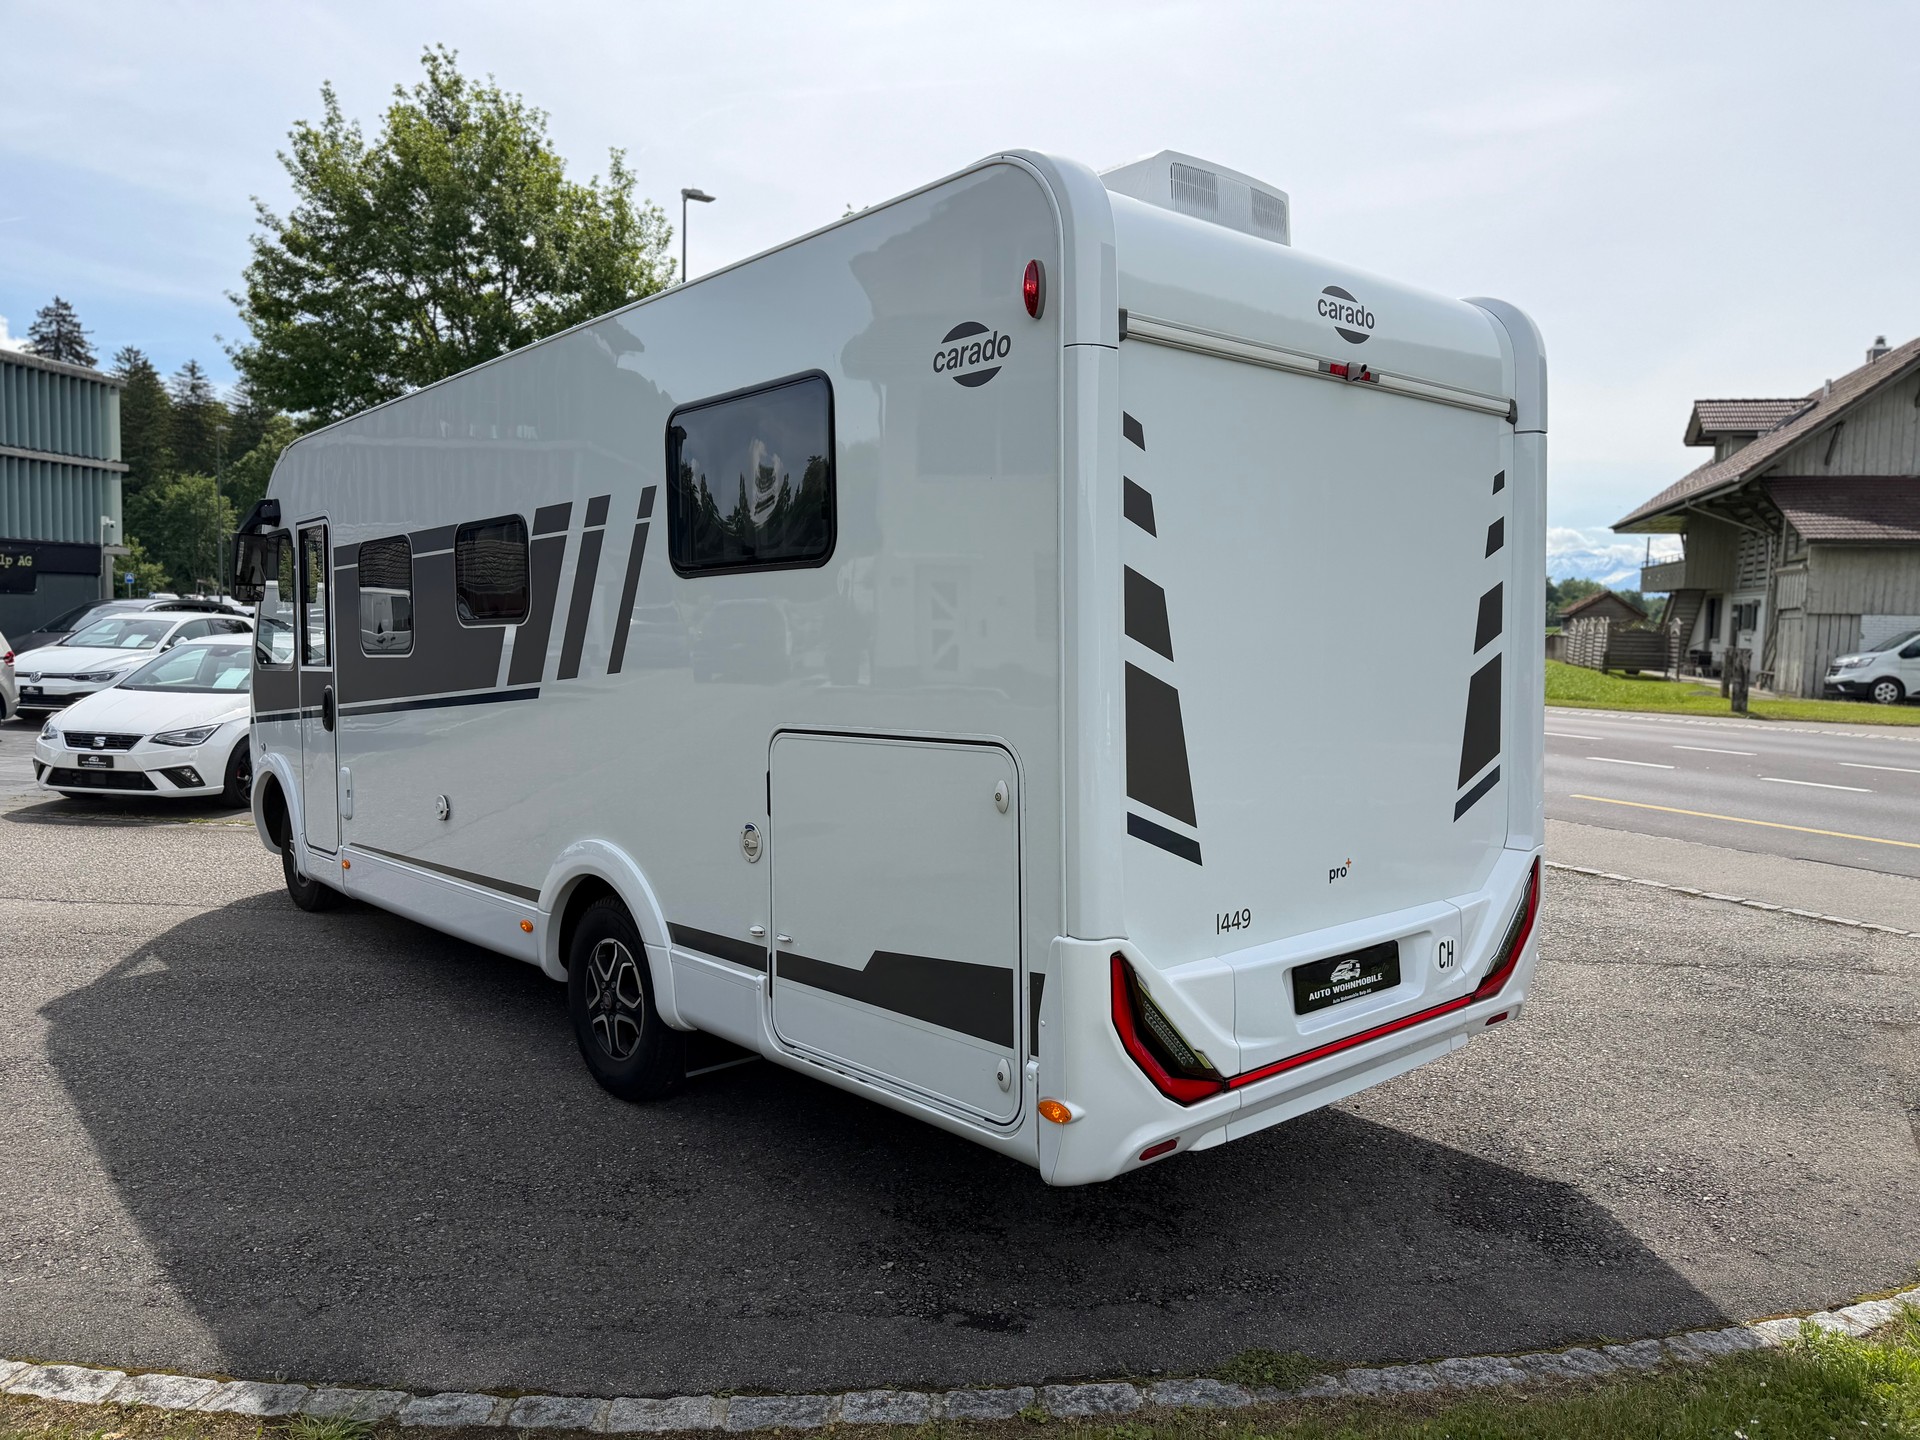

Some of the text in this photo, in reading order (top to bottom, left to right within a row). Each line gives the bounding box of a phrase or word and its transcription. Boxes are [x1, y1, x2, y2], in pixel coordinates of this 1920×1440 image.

[1317, 298, 1375, 330] carado
[933, 330, 1011, 373] carado
[17, 555, 33, 567] AG
[1439, 939, 1454, 969] CH
[1309, 972, 1383, 1001] AUTO WOHNMOBILE
